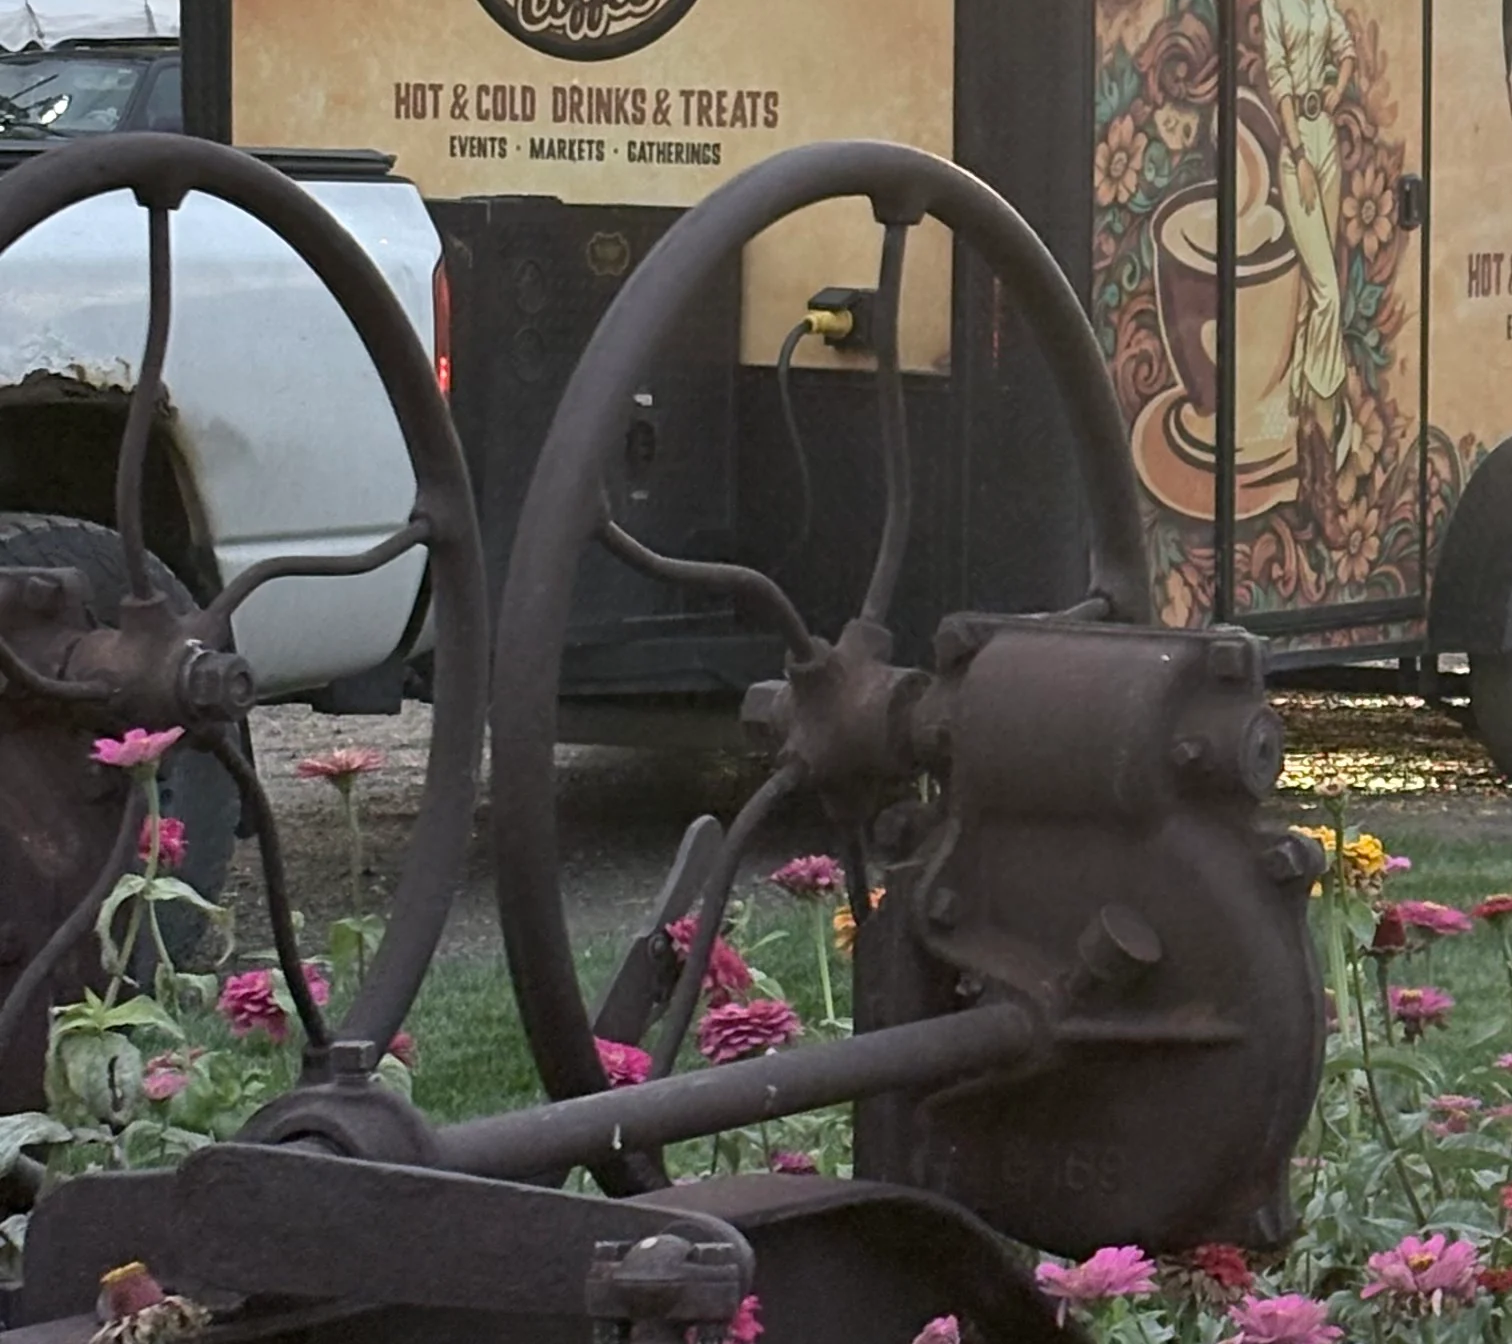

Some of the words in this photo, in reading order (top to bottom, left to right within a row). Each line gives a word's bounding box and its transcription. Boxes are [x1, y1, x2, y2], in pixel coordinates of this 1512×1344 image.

[394, 82, 444, 120] HOT
[449, 83, 470, 121] &
[476, 84, 536, 122] COLD
[551, 85, 647, 126] DRINKS
[652, 88, 672, 127] &
[679, 89, 780, 129] TREATS
[448, 135, 508, 159] EVENTS
[528, 137, 606, 162] MARKETS
[626, 139, 722, 165] GATHERINGS
[1467, 252, 1504, 298] HOT
